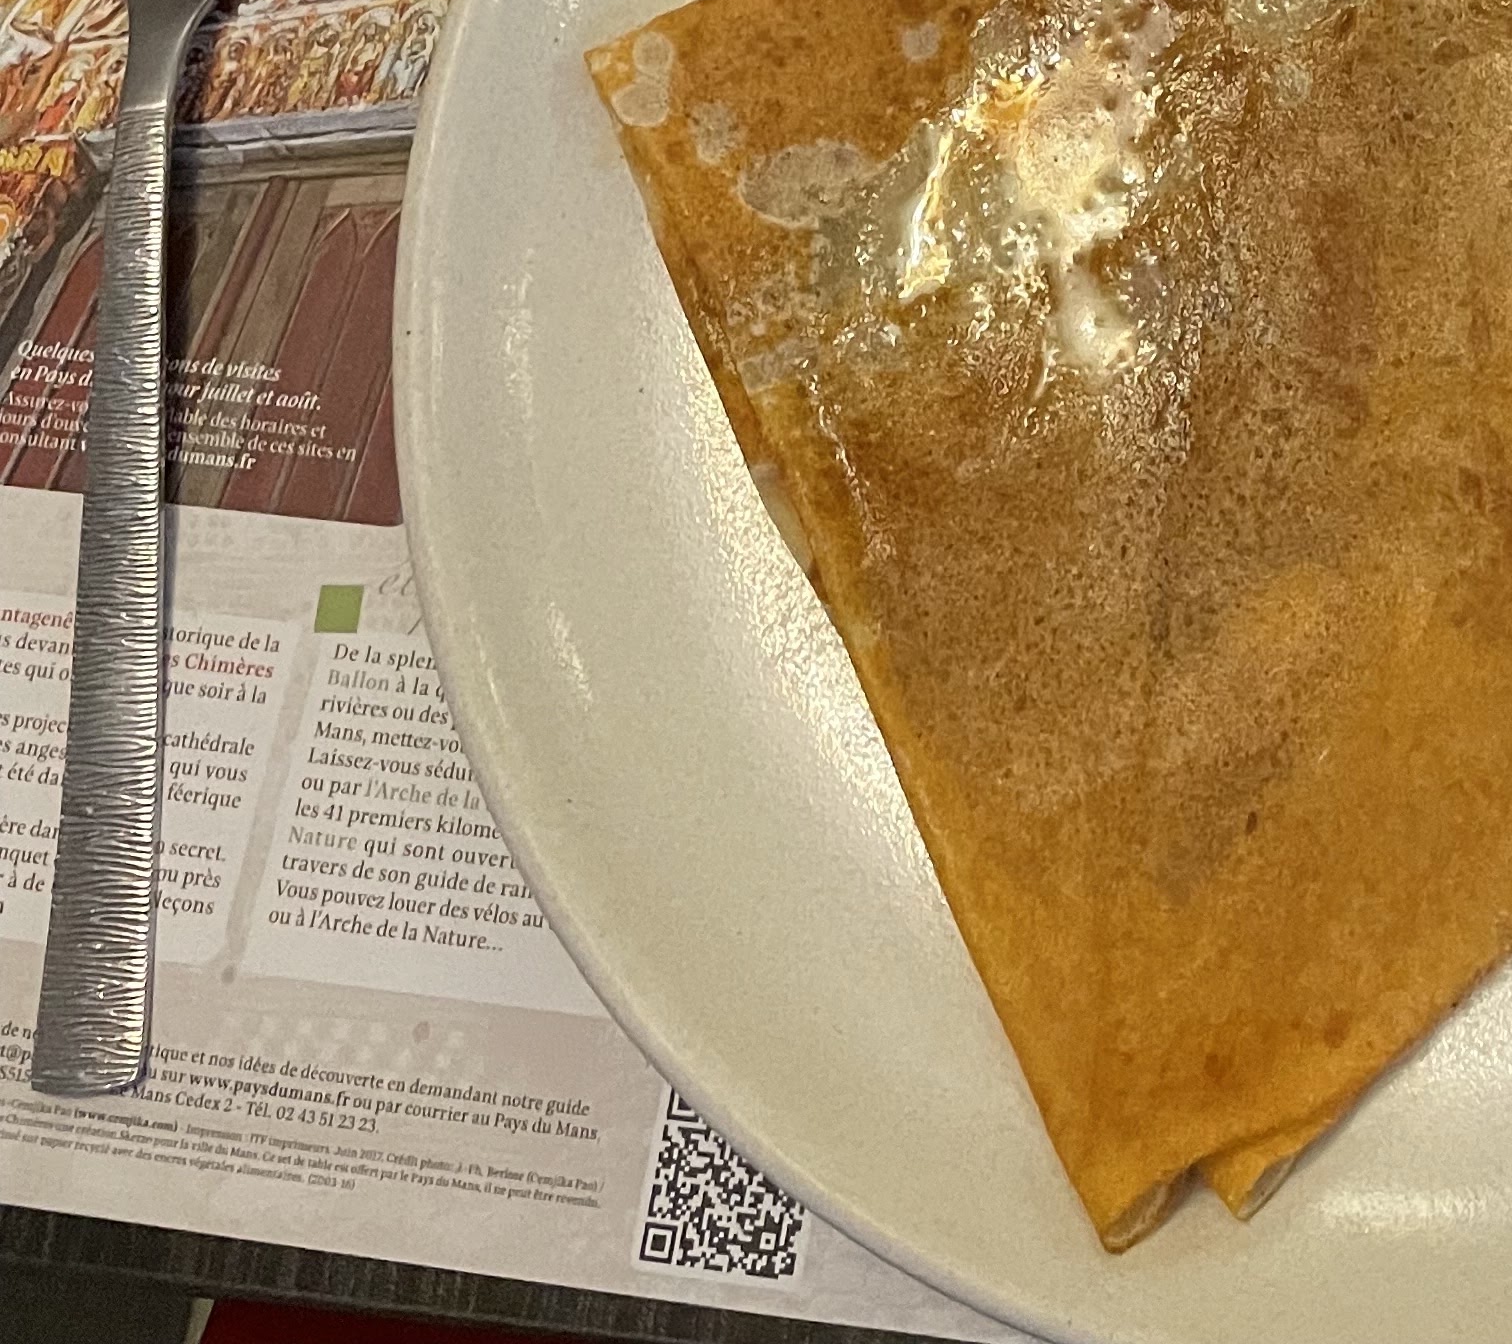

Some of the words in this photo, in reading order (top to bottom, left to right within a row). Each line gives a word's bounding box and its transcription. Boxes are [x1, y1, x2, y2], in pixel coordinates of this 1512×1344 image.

[35, 366, 77, 388] Pays
[226, 361, 282, 382] visites
[197, 381, 254, 403] juillet
[275, 391, 321, 411] août.
[240, 413, 307, 436] horaires
[297, 440, 333, 458] sites
[185, 653, 274, 678] Chimères
[198, 682, 234, 701] soir
[327, 669, 389, 692] Ballon
[320, 695, 388, 718] rivières
[163, 731, 255, 756] cathédrale
[169, 759, 201, 779] qui
[206, 764, 248, 782] vous
[307, 747, 420, 775] Laissez-vous
[323, 804, 343, 822] 41
[347, 809, 432, 832] premiers
[288, 825, 358, 851] Nature
[402, 843, 445, 861] sont
[282, 854, 348, 877] travers
[414, 870, 469, 891] guide
[276, 878, 318, 900] Vous
[321, 887, 385, 912] pouvez
[388, 891, 437, 914] louer
[473, 903, 519, 925] vélos
[308, 908, 373, 935] l'Arche
[300, 1064, 385, 1090] découverte
[409, 1078, 498, 1105] demandant
[501, 1093, 543, 1111] notre
[545, 1099, 590, 1116] guide
[175, 1091, 221, 1112] Cedex
[223, 1098, 233, 1112] 2
[276, 1106, 294, 1121] 02
[297, 1109, 316, 1124] 43
[318, 1113, 334, 1127] 51
[337, 1115, 356, 1130] 23
[190, 1073, 350, 1108] www.paysdumans.fr
[405, 1103, 469, 1123] courrier
[493, 1112, 528, 1134] Pays
